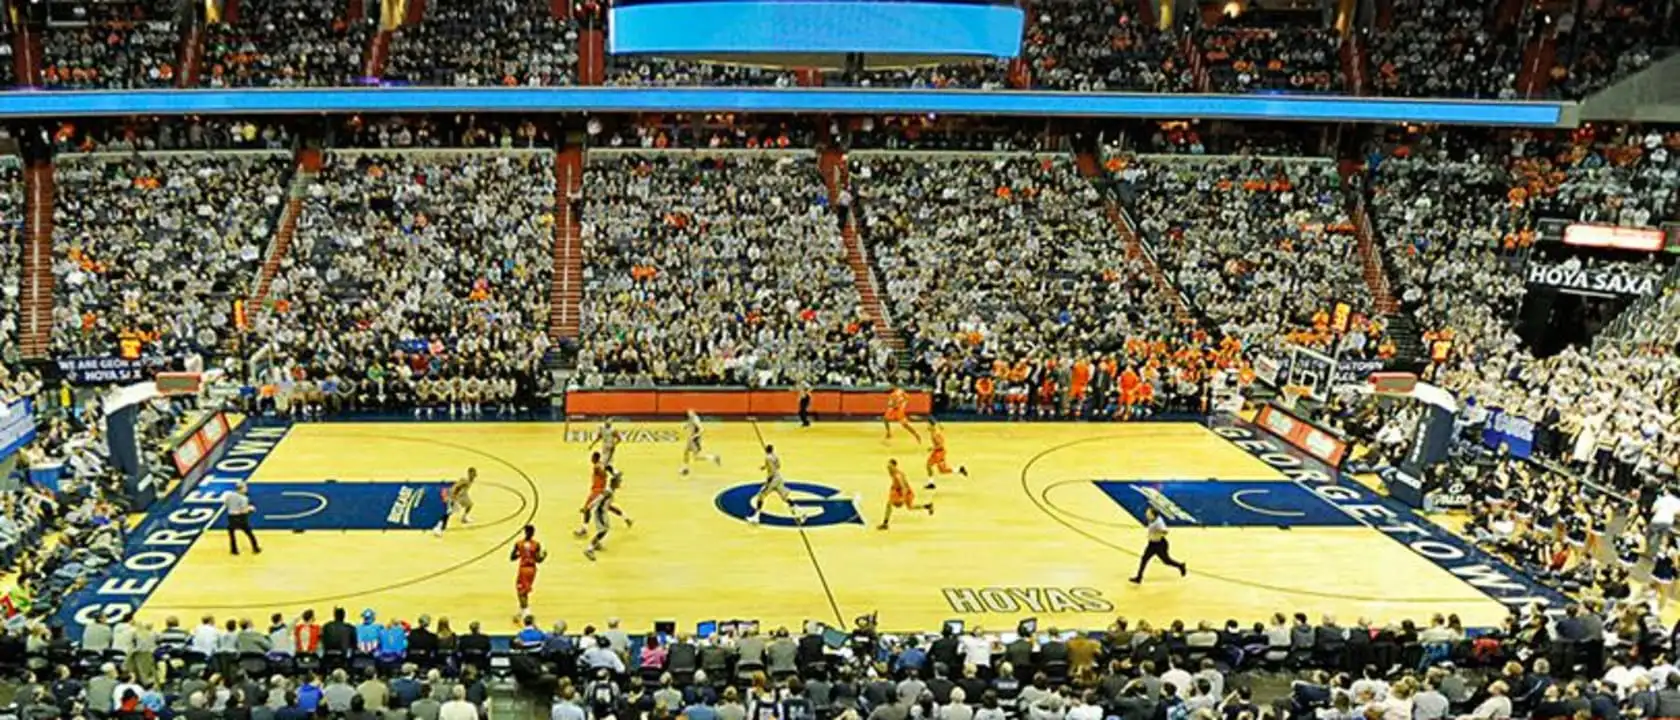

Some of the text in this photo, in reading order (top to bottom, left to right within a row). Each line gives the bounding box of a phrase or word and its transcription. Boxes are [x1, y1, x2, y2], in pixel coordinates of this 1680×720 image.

[1529, 264, 1654, 295] HOYA SAXA
[78, 358, 98, 370] ARE
[74, 427, 286, 625] GEORGETOWN
[942, 587, 1114, 613] HOYAS
